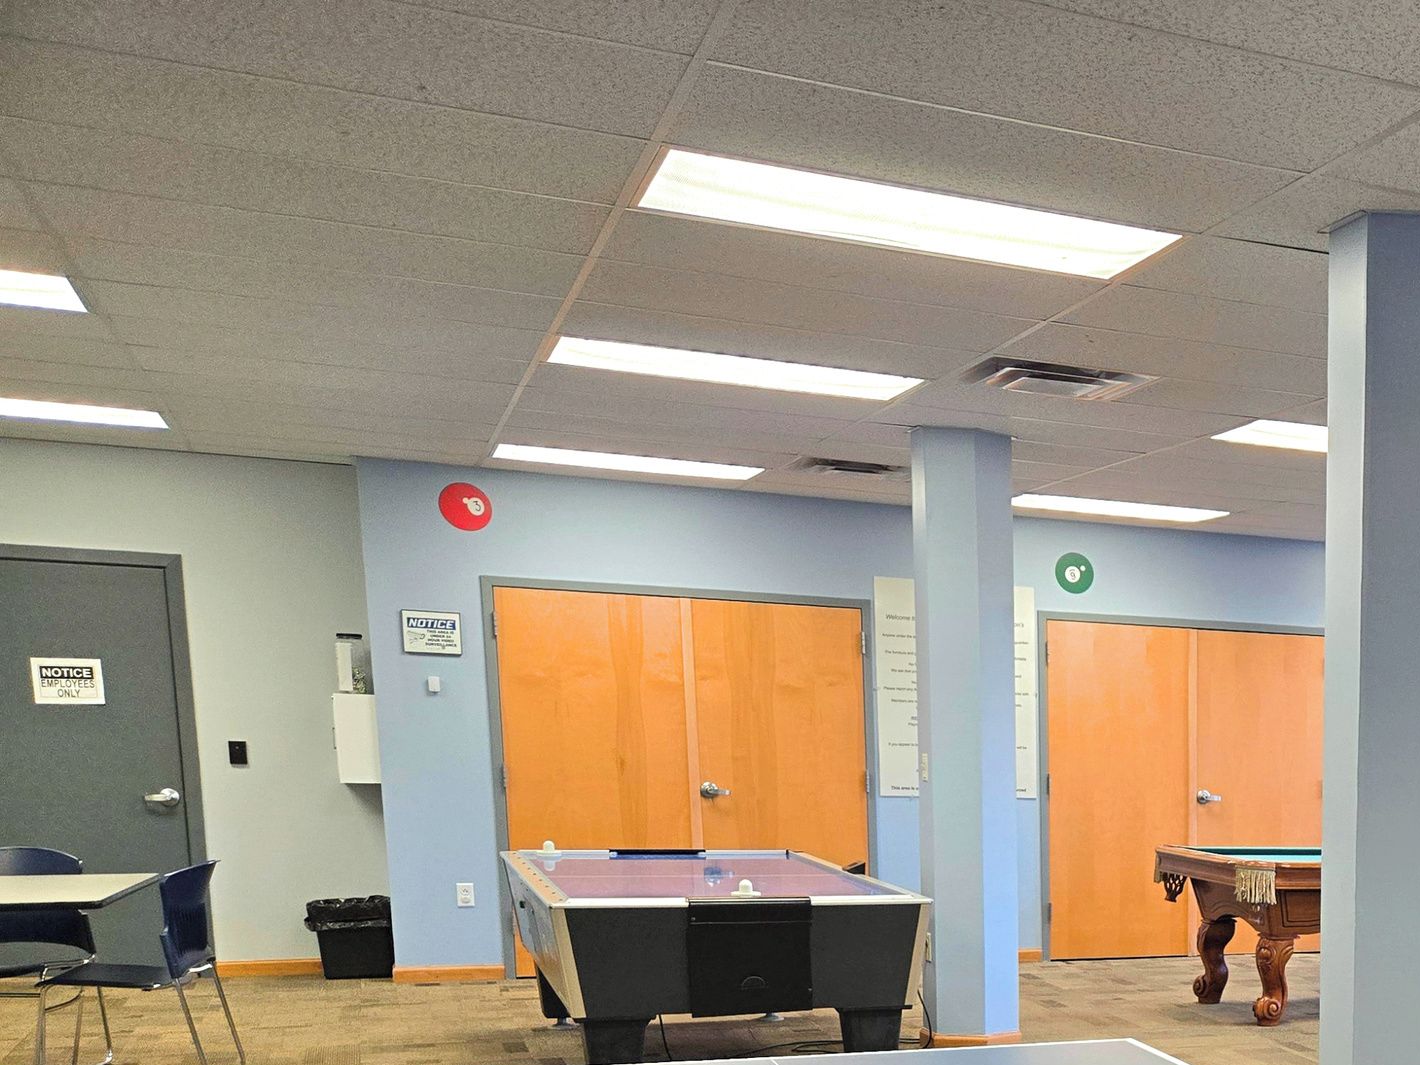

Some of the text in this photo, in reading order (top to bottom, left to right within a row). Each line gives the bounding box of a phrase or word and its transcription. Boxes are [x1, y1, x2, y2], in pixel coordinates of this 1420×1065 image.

[473, 500, 481, 512] 3
[885, 613, 911, 621] Welcome
[408, 618, 455, 630] NOTICE
[41, 668, 92, 678] NOTICE
[41, 679, 95, 689] EMPLOYEES
[57, 688, 80, 698] ONLY
